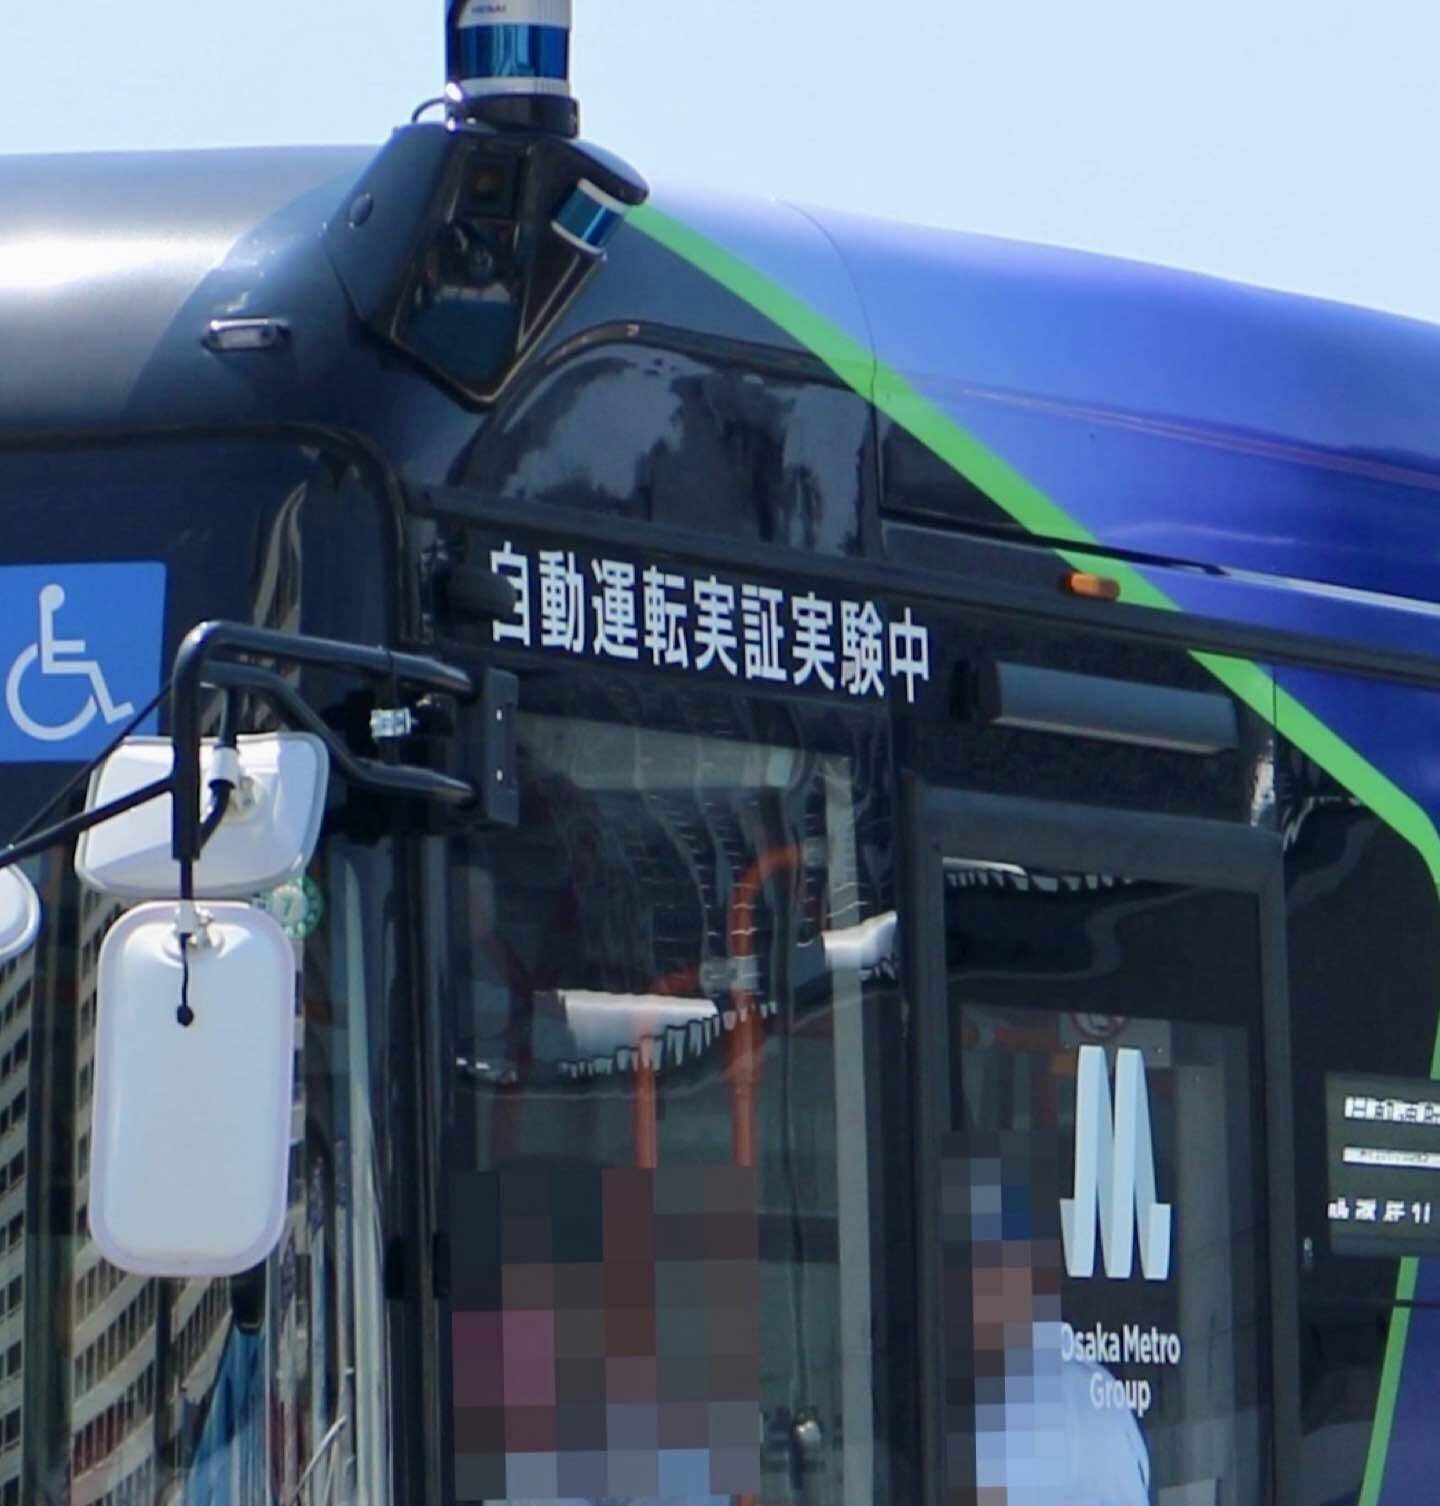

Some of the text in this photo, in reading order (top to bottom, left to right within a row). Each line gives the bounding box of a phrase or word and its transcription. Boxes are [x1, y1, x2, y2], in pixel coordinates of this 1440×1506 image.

[489, 541, 929, 703] 自動運転実証実験中
[1060, 1321, 1181, 1364] Osaka Metro
[1089, 1372, 1151, 1418] Group
